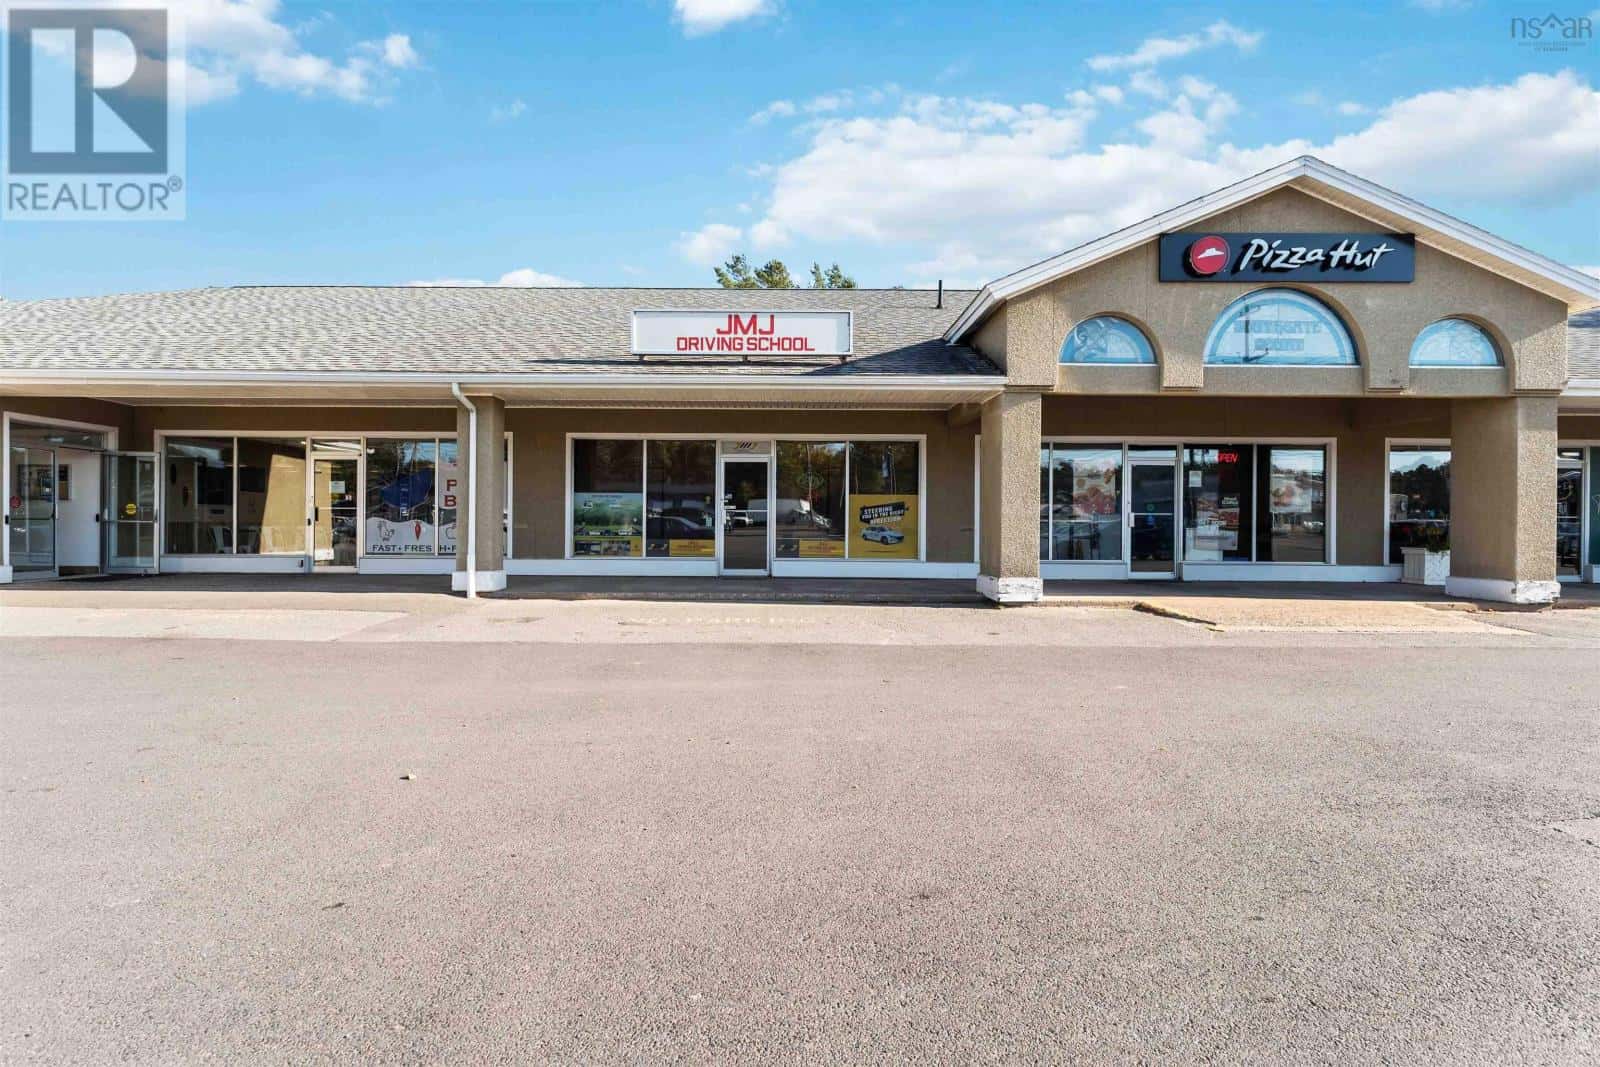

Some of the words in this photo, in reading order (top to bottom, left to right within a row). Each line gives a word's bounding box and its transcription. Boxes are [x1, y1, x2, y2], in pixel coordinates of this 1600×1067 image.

[1239, 238, 1325, 271] Pizza
[1329, 239, 1395, 268] Hut
[716, 314, 775, 335] JMJ
[676, 337, 743, 351] DRIVING
[746, 337, 815, 351] SCHOOL
[1215, 452, 1238, 463] OPEN
[372, 544, 396, 552] FAST
